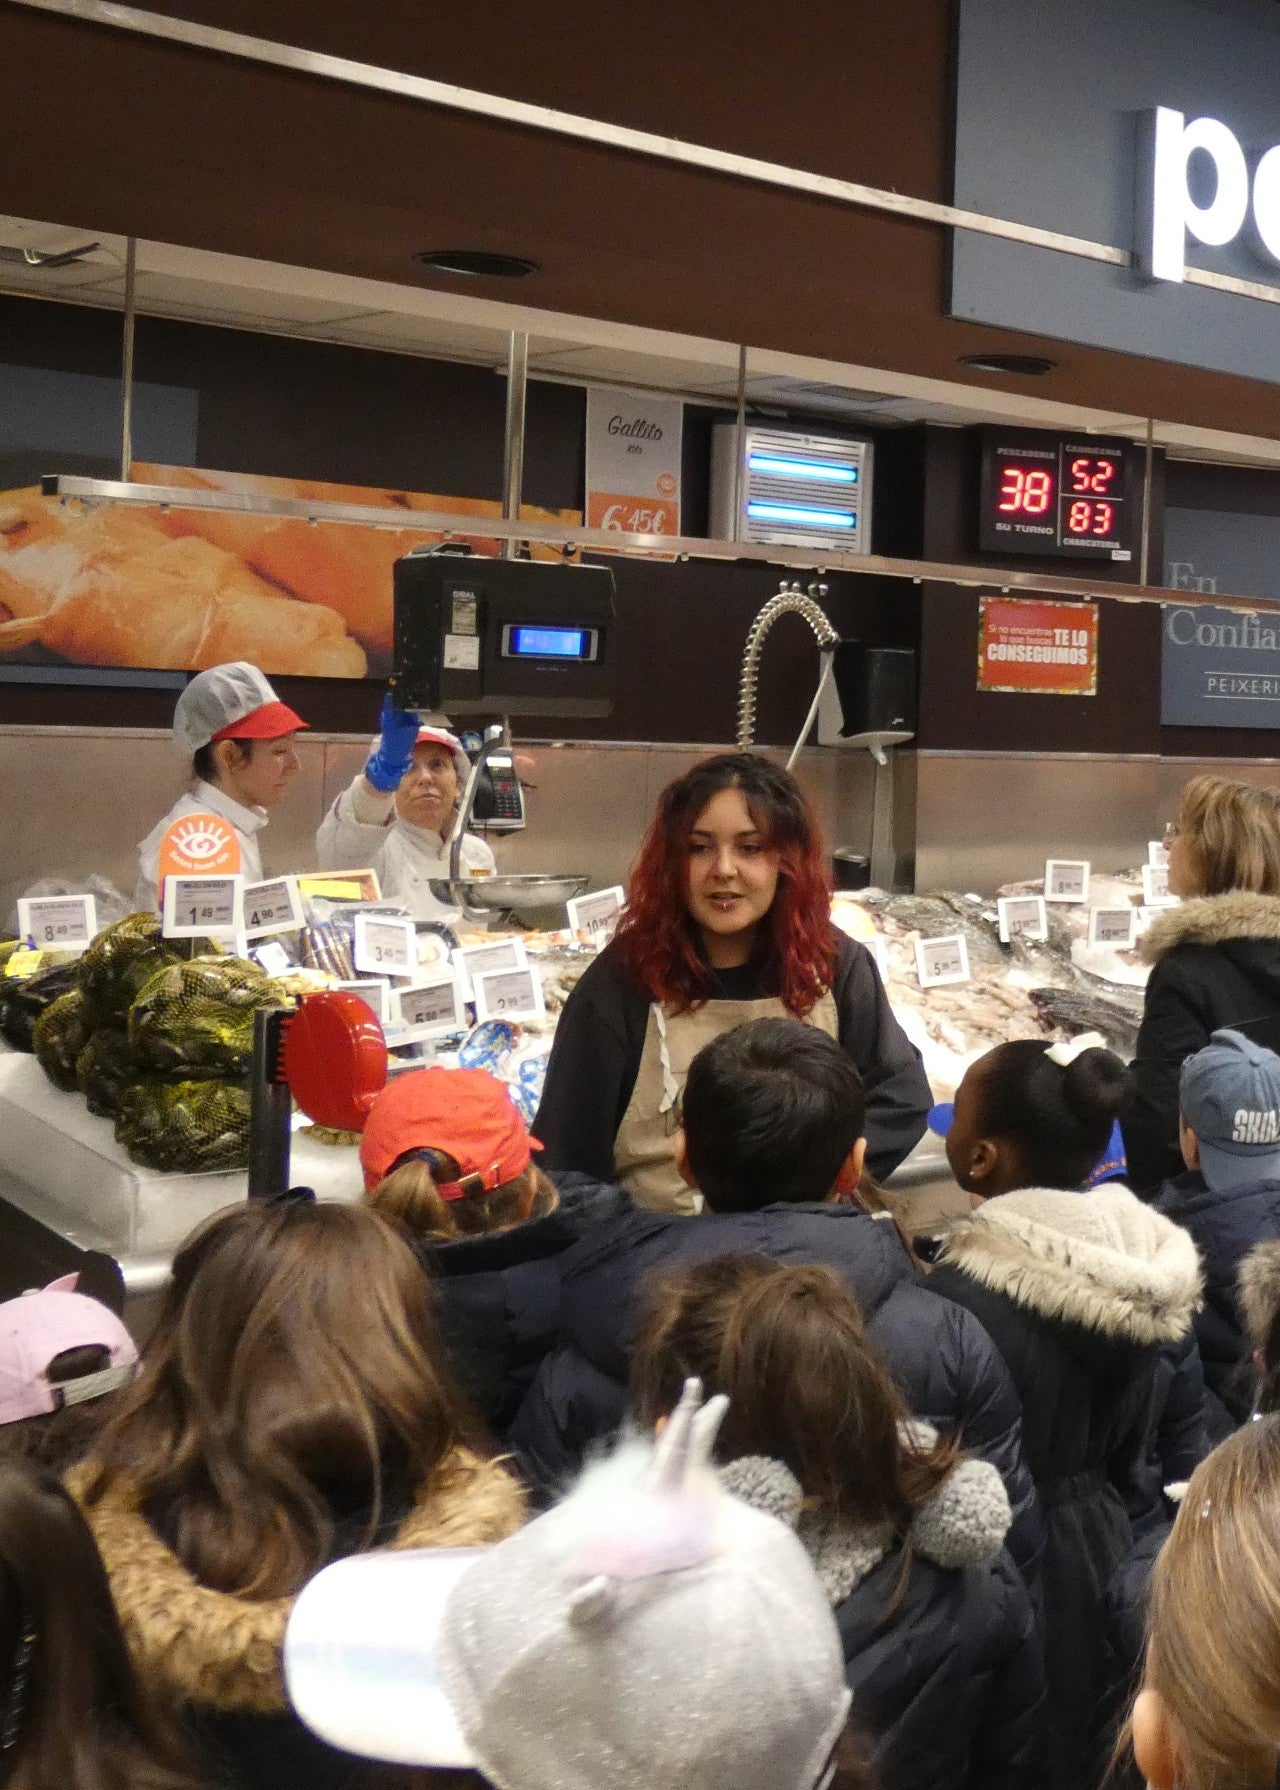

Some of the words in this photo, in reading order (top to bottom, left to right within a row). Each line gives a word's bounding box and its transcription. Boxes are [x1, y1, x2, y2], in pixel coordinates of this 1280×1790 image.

[608, 415, 663, 441] Gallito
[1071, 459, 1114, 493] 52
[999, 468, 1051, 513] 38
[995, 522, 1011, 532] SU
[1014, 523, 1054, 535] TURNO
[1068, 501, 1112, 534] 83
[1053, 628, 1069, 646] TE
[1071, 629, 1088, 647] LO
[987, 643, 1088, 665] CONSEGUIMOS
